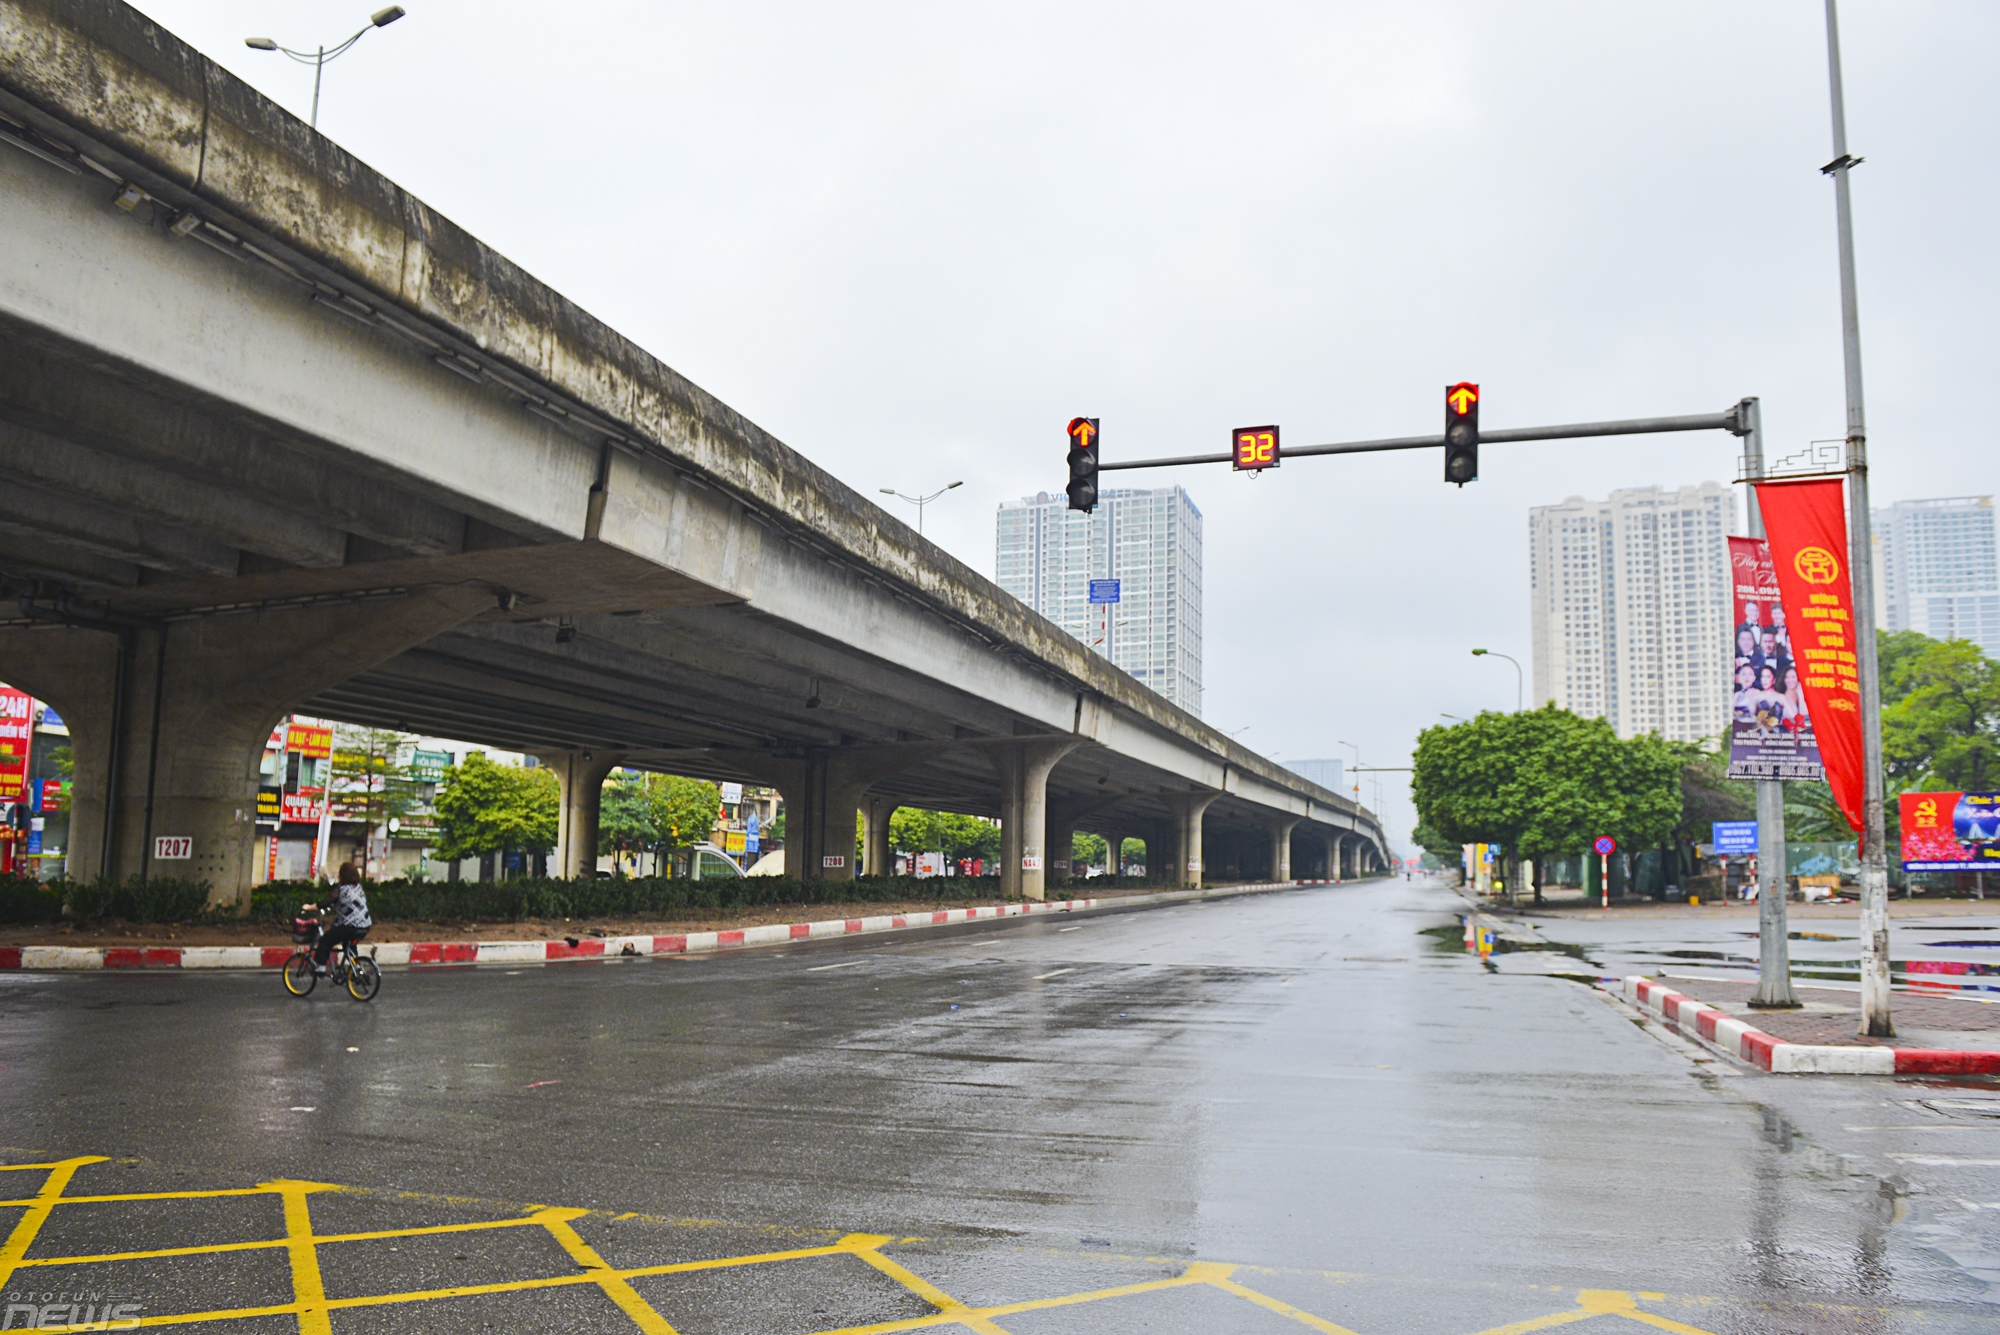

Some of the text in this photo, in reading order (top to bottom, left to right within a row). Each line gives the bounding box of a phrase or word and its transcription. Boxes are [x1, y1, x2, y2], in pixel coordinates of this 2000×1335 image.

[1240, 433, 1274, 463] 32
[1803, 648, 1838, 661] THANH
[1809, 664, 1835, 675] PHÁT
[292, 808, 320, 819] LED
[158, 839, 190, 857] T207
[825, 857, 843, 866] T208
